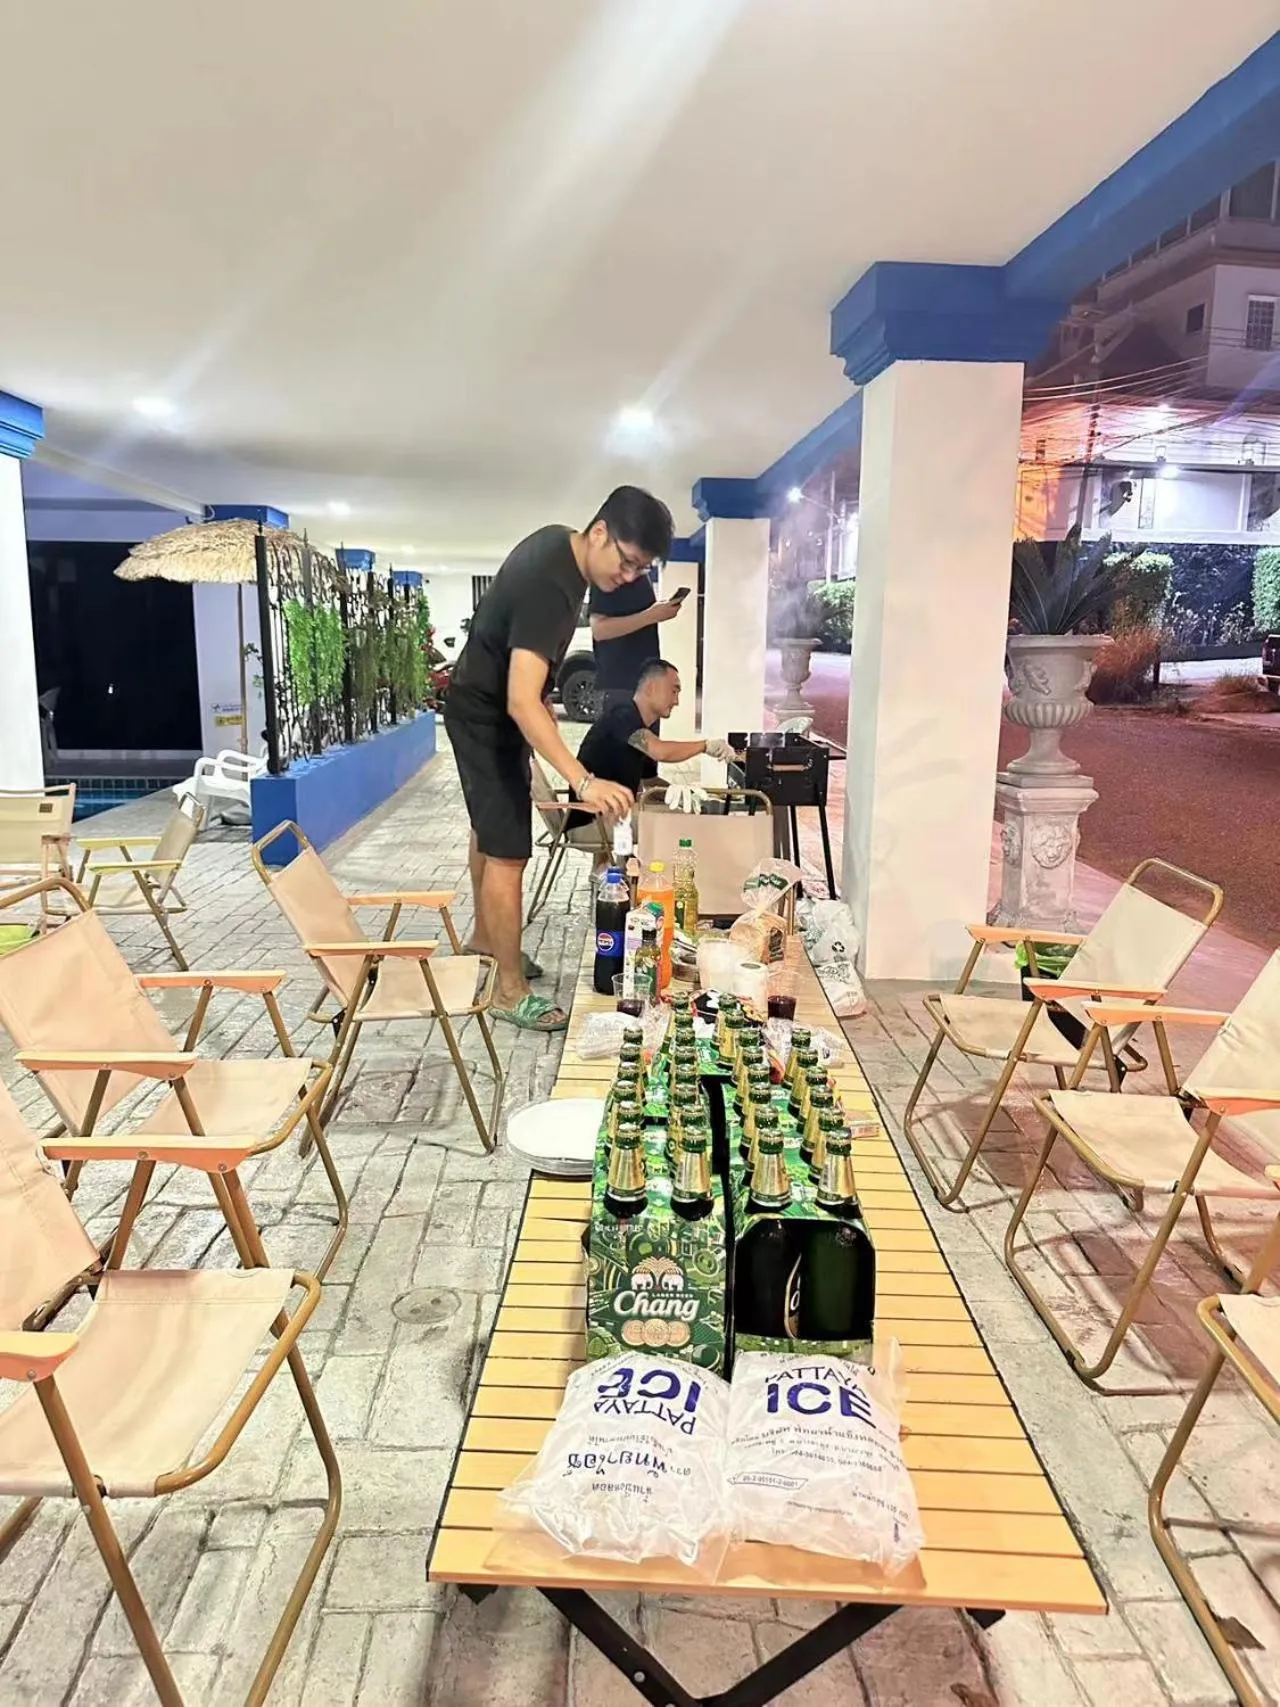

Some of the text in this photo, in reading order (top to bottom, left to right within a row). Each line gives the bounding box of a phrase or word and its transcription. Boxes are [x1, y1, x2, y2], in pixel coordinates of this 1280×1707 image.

[613, 1290, 701, 1322] Chang
[597, 1367, 701, 1413] ICE
[766, 1382, 876, 1429] ICE
[594, 1400, 697, 1435] PATTAYA
